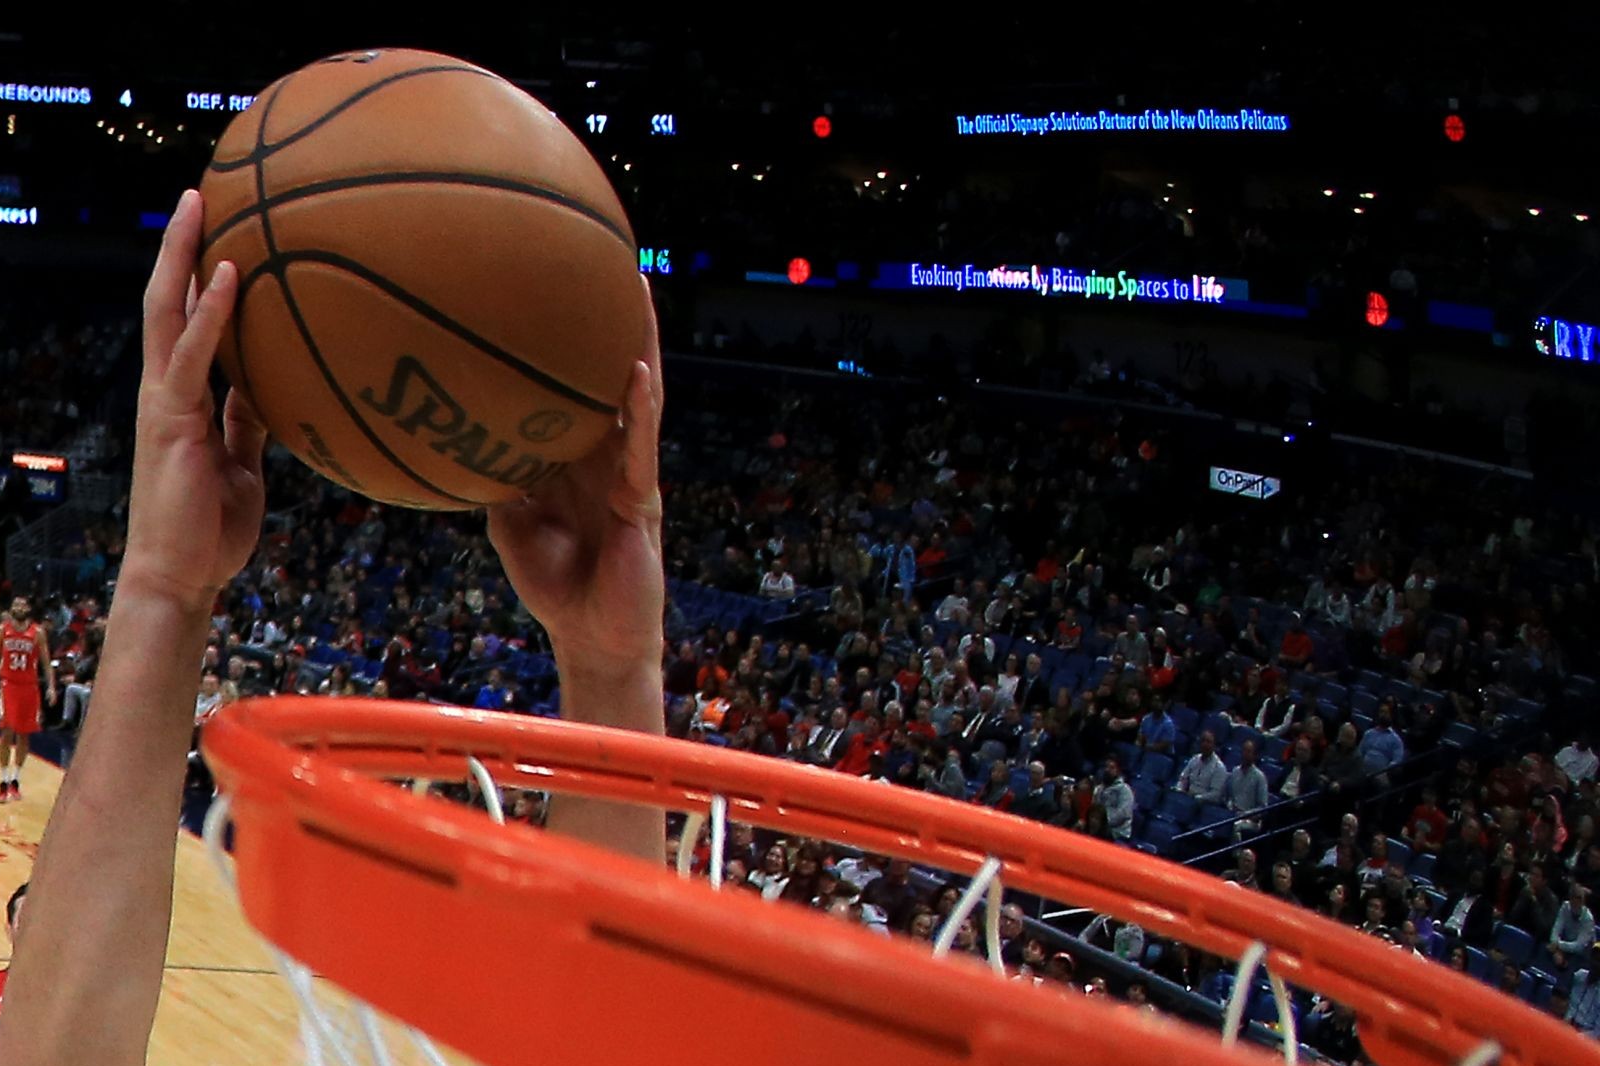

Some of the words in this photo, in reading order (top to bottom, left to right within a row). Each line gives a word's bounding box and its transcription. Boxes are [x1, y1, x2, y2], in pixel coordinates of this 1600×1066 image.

[119, 89, 132, 107] 4
[187, 92, 224, 111] DEF.
[228, 95, 258, 111] RE
[586, 113, 608, 133] 17
[957, 116, 973, 134] The
[975, 114, 1009, 134] Official
[1010, 113, 1049, 136] Signage
[1050, 111, 1098, 131] Solutions
[1099, 110, 1136, 130] Partner
[1138, 109, 1150, 130] of
[1151, 110, 1169, 130] the
[1170, 109, 1196, 130] New
[1197, 108, 1239, 130] Orleans
[1241, 109, 1287, 130] Pelicans
[911, 263, 962, 291] Evoking
[965, 264, 1030, 289] Emotions
[1031, 264, 1048, 296] by
[1052, 267, 1115, 300] Bringing
[1118, 270, 1169, 301] Spaces
[1173, 278, 1188, 300] to
[1193, 274, 1225, 302] Life
[10, 653, 27, 671] 34
